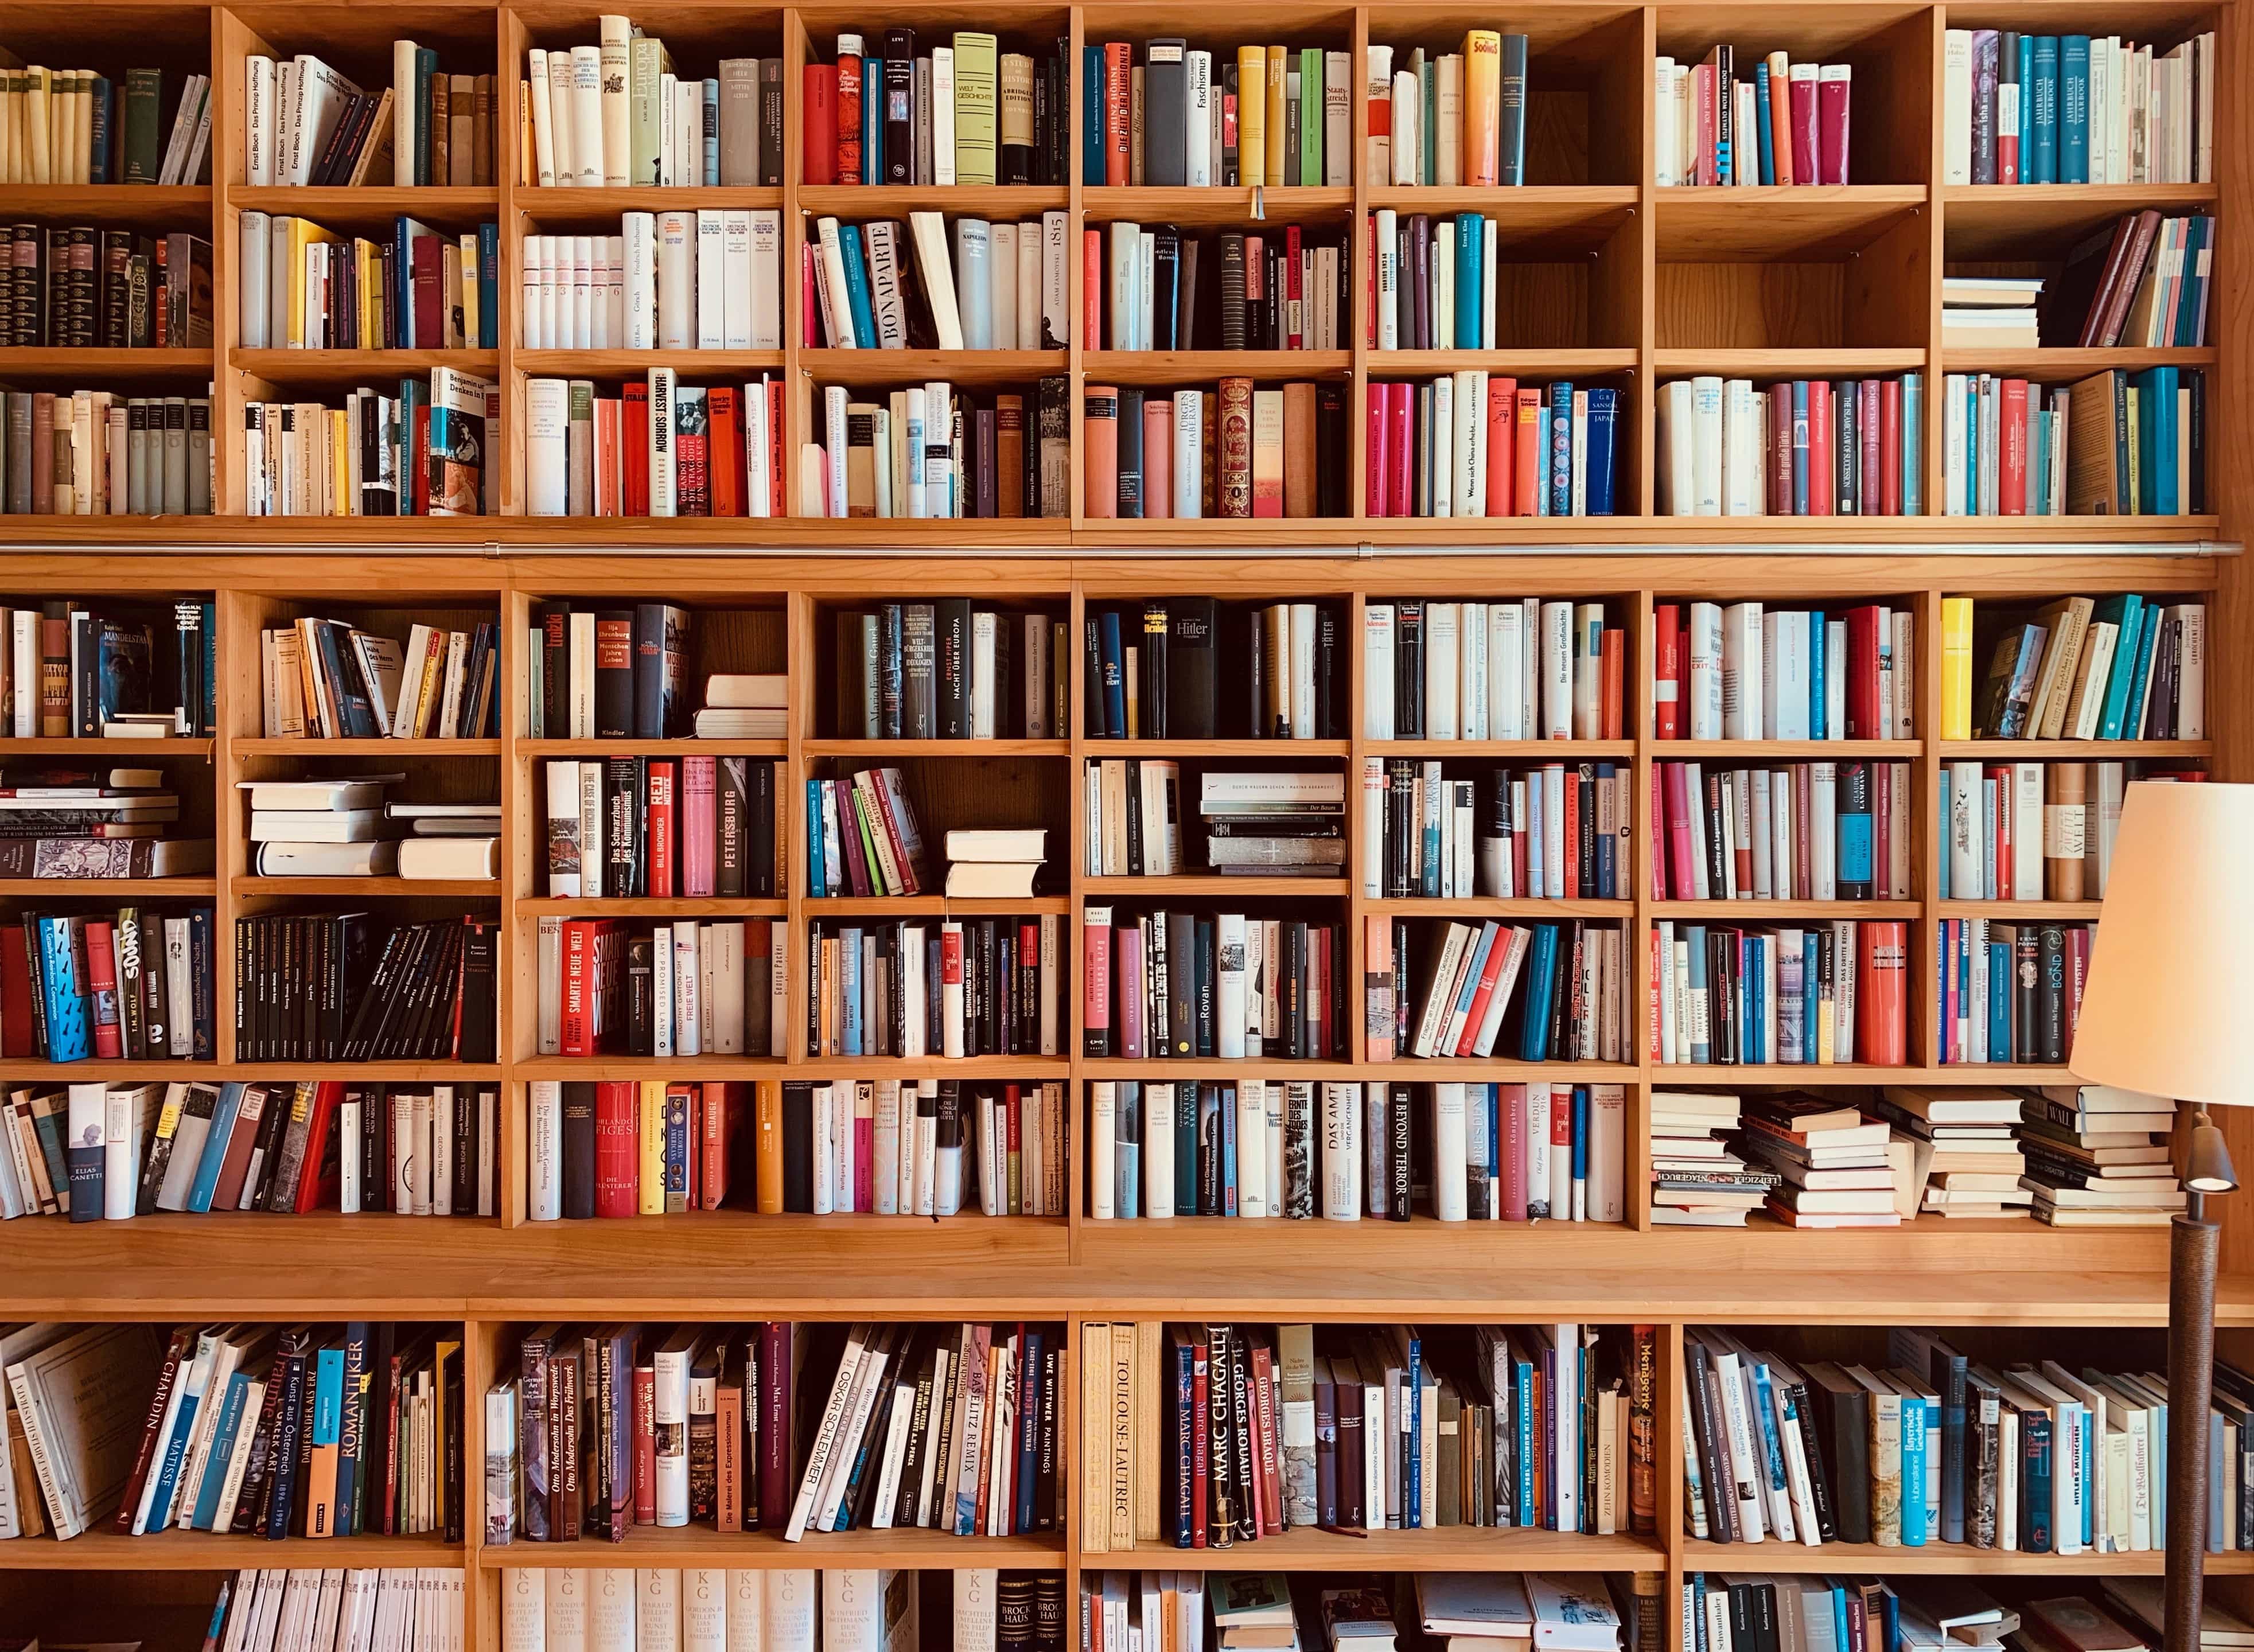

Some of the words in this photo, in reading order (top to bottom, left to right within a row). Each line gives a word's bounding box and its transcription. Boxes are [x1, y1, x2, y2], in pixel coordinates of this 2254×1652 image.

[298, 60, 306, 89] Hoffnung
[1197, 58, 1206, 109] Faschismus
[1326, 86, 1348, 95] Staats-
[957, 92, 994, 101] GESCHICHTE
[1326, 93, 1348, 102] streich
[1050, 219, 1063, 247] 1815
[560, 287, 566, 295] 3
[577, 287, 583, 296] 4
[597, 288, 602, 297] 5
[614, 287, 620, 296] 6
[872, 225, 898, 340] BONAPARTE
[655, 376, 667, 411] HARVEST
[1179, 393, 1188, 431] JÜRGEN
[656, 416, 667, 453] SORROW
[1780, 430, 1790, 449] Türke
[1778, 466, 1790, 480] Der
[1779, 450, 1791, 466] große
[546, 614, 563, 647] trotzki
[598, 631, 630, 639] Ehrenburg
[1144, 624, 1167, 633] Henker
[1175, 621, 1208, 634] Hitler
[1560, 608, 1568, 649] Großmächte
[651, 776, 663, 805] RED
[610, 796, 620, 848] Schwarzbuch
[621, 790, 632, 848] Kommunismus
[656, 817, 665, 853] BROWDER
[725, 790, 736, 868] PETERSBURG
[2074, 809, 2084, 853] WELT
[611, 850, 620, 863] Das
[624, 850, 632, 863] des
[656, 854, 665, 868] BILL
[122, 919, 140, 980] SOUND
[570, 930, 583, 952] WELT
[660, 943, 666, 957] MY
[774, 944, 783, 968] Packer
[1252, 928, 1260, 968] Churchill
[570, 953, 582, 977] NEUE
[2051, 954, 2062, 988] BOND
[569, 979, 582, 1014] SMARTE
[686, 975, 694, 1001] WELT
[774, 971, 784, 995] George
[1650, 988, 1658, 1004] UDE
[1200, 985, 1209, 1019] Rovan
[1650, 1005, 1659, 1052] CHRISTIAN
[708, 1101, 717, 1139] WILDAUGE
[1328, 1087, 1338, 1119] AMT
[1328, 1122, 1338, 1150] DAS
[1395, 1104, 1407, 1150] BEYOND
[70, 1172, 102, 1181] CANETTI
[1395, 1153, 1407, 1195] TERROR
[601, 1347, 609, 1375] Erich
[1212, 1332, 1227, 1422] CHAGALL
[146, 1361, 175, 1429] CHARDIN
[229, 1381, 244, 1411] Hockney
[289, 1376, 300, 1400] Kunst
[341, 1339, 363, 1458] ROMANTIKER
[550, 1364, 562, 1411] Worpswede
[563, 1364, 574, 1405] Frühwerk
[601, 1376, 610, 1413] Heckel
[827, 1370, 852, 1412] OSKAR
[968, 1372, 983, 1429] BASELITZ
[1045, 1378, 1053, 1421] WITTWER
[1233, 1364, 1247, 1423] GEORGES
[1259, 1376, 1271, 1428] GEORGES
[225, 1412, 235, 1433] David
[286, 1404, 295, 1421] aus
[551, 1413, 559, 1423] in
[565, 1406, 574, 1423] Das
[1179, 1409, 1190, 1451] MARC
[1197, 1401, 1206, 1431] Marc
[1904, 1406, 1915, 1452] Bayerische
[1915, 1406, 1924, 1452] Geschichte
[281, 1423, 295, 1476] Österreich
[551, 1425, 559, 1472] Modersohn
[565, 1425, 575, 1472] Modersohn
[725, 1410, 734, 1470] Expressionismus
[806, 1412, 839, 1485] SCHLEMMER
[964, 1433, 977, 1474] REMIX
[1043, 1426, 1051, 1474] PAINTINGS
[1115, 1359, 1129, 1517] TOULOUSE-LAUTREC
[1195, 1433, 1206, 1476] Chagall
[1213, 1426, 1228, 1482] MARC
[1262, 1430, 1274, 1476] BRAQUE
[161, 1439, 181, 1488] MATISSE
[1237, 1427, 1251, 1488] ROUAULT
[551, 1474, 560, 1493] Otto
[566, 1474, 575, 1492] Otto
[1179, 1454, 1190, 1519] CHAGALL
[1910, 1454, 1919, 1504] Hubensteiner
[275, 1509, 283, 1527] 1996
[1002, 1604, 1031, 1615] BROCK
[1004, 1614, 1029, 1623] HAUS
